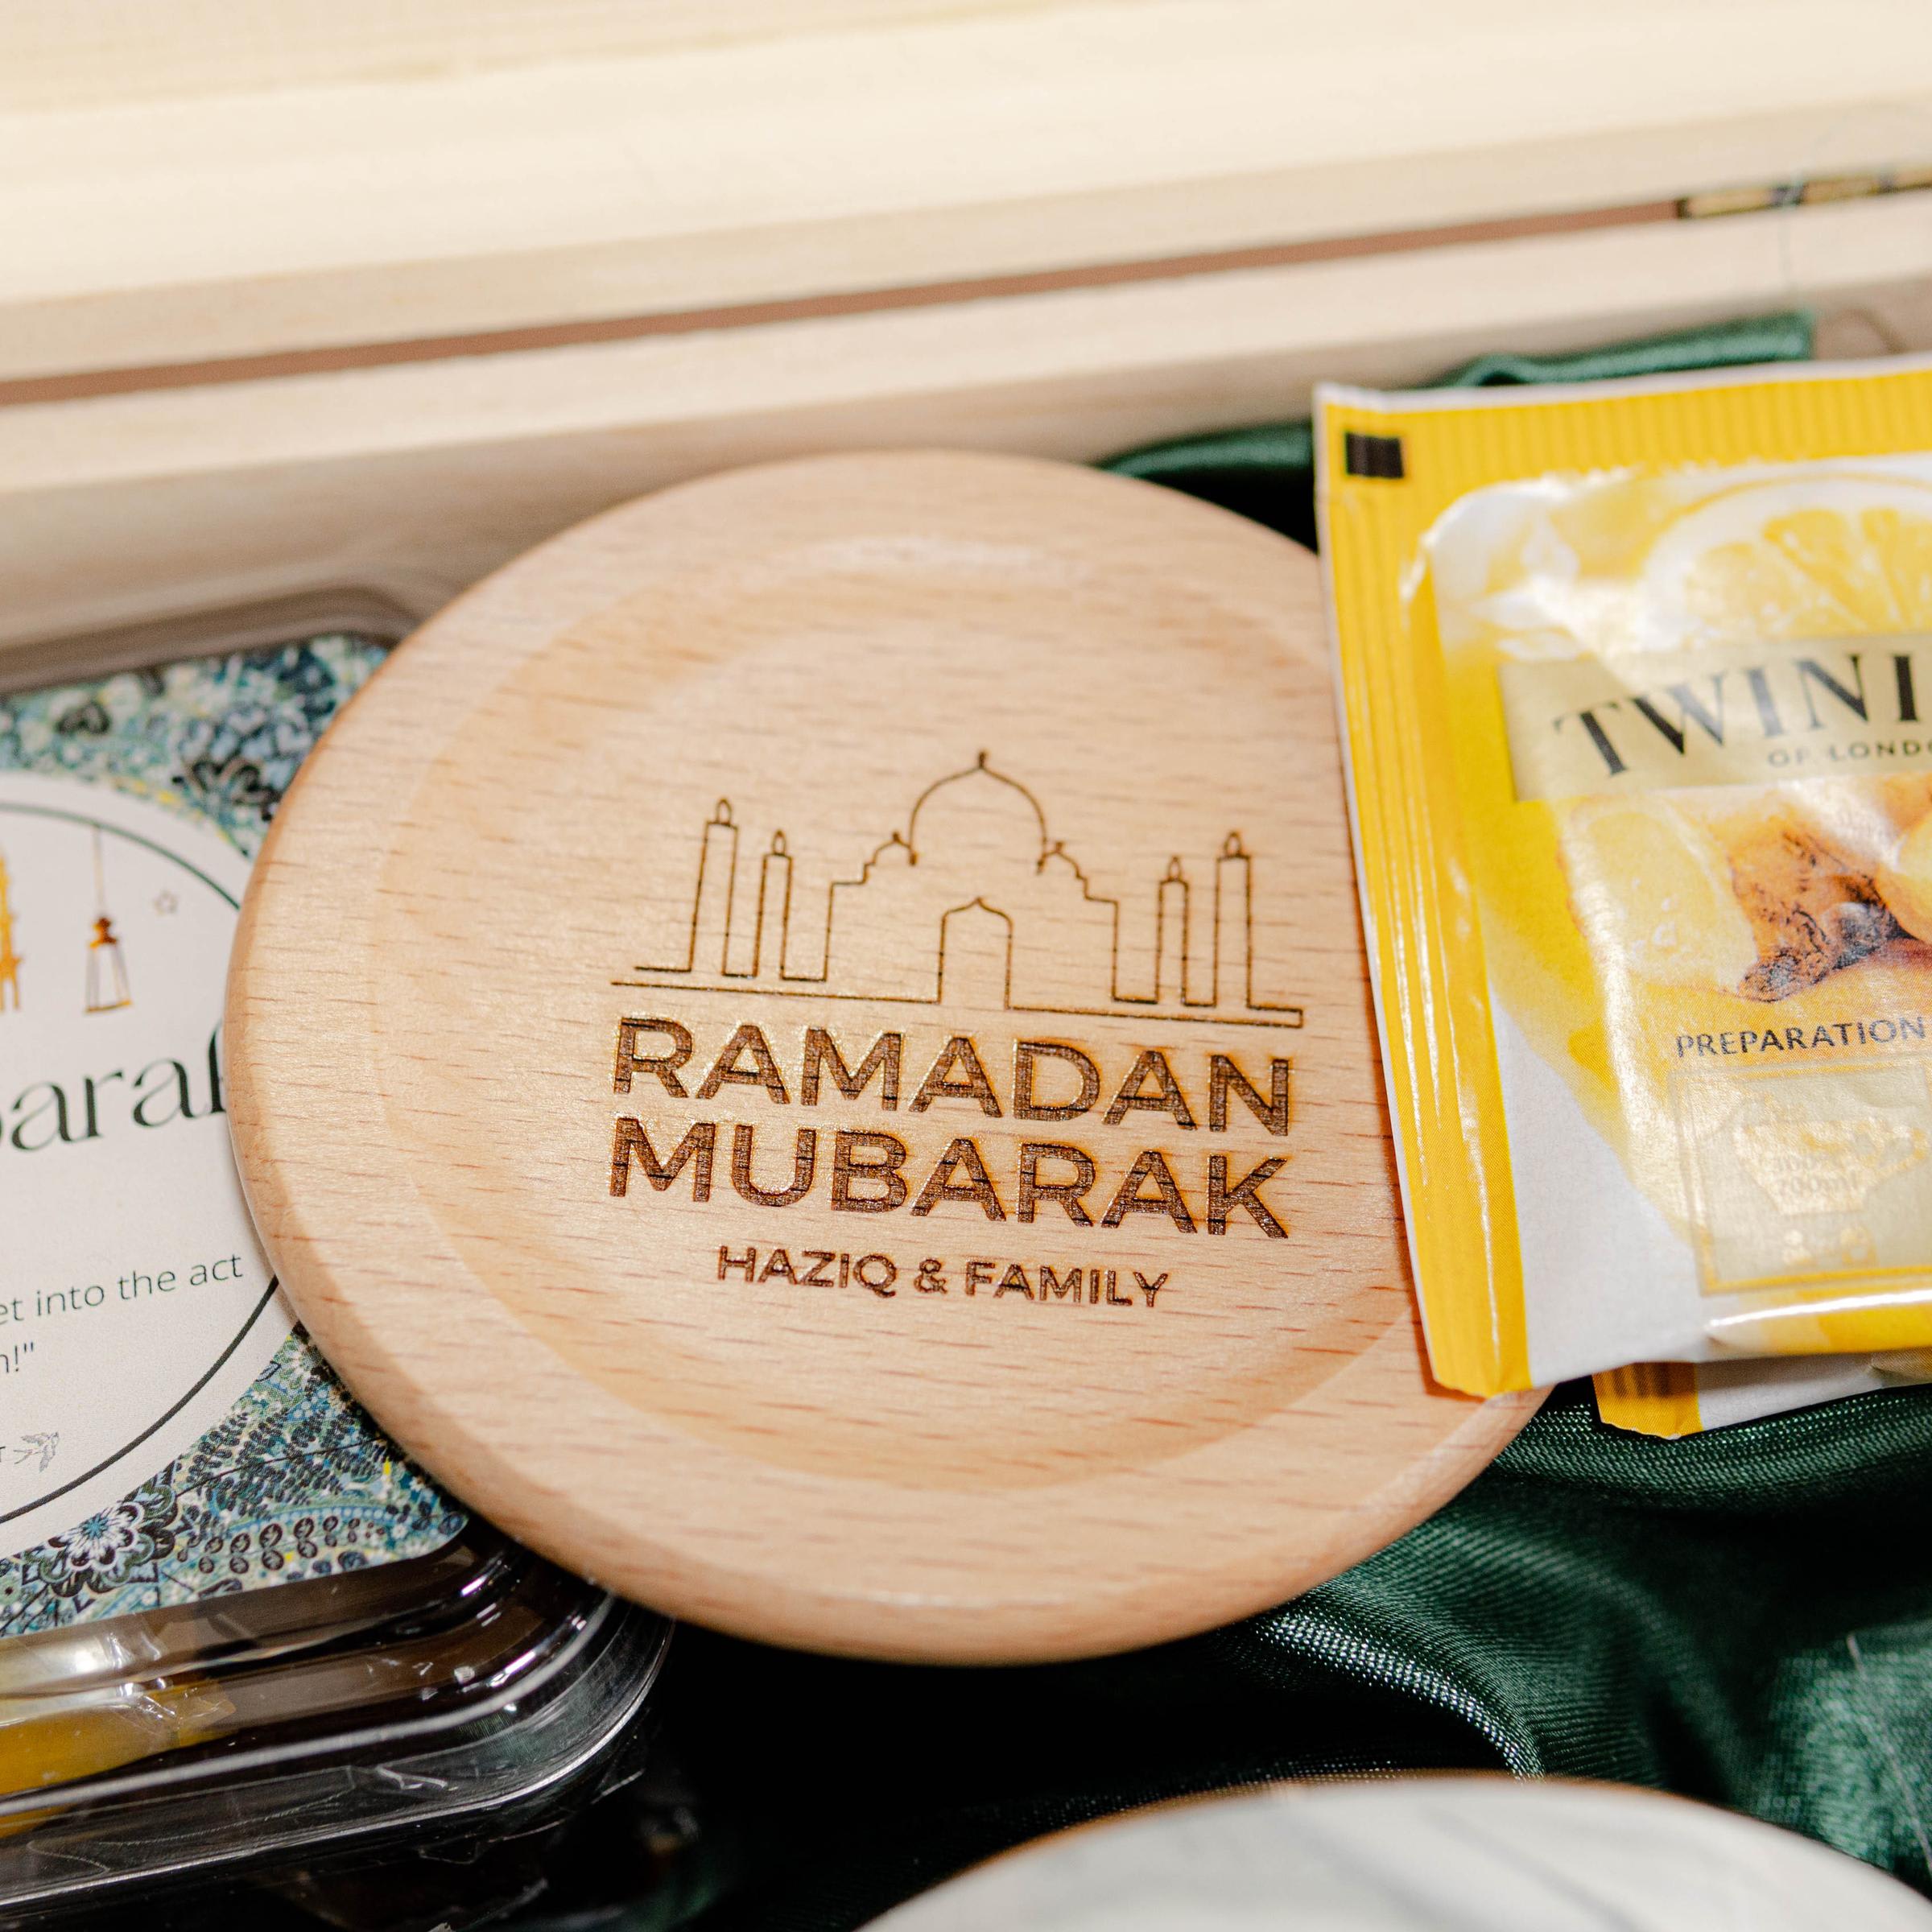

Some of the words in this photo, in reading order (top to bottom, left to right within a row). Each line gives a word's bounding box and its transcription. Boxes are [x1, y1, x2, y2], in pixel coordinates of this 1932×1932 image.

[1827, 739, 1932, 762] LOND
[1675, 1017, 1926, 1058] PREPARATION
[613, 1017, 1290, 1137] RAMADAN
[609, 1117, 1290, 1239] MUBARAK
[37, 1286, 105, 1318] into
[118, 1269, 176, 1300] the
[189, 1254, 244, 1286] act
[717, 1245, 898, 1298] HAZIQ
[912, 1258, 949, 1294] &
[964, 1261, 1168, 1308] FAMILY
